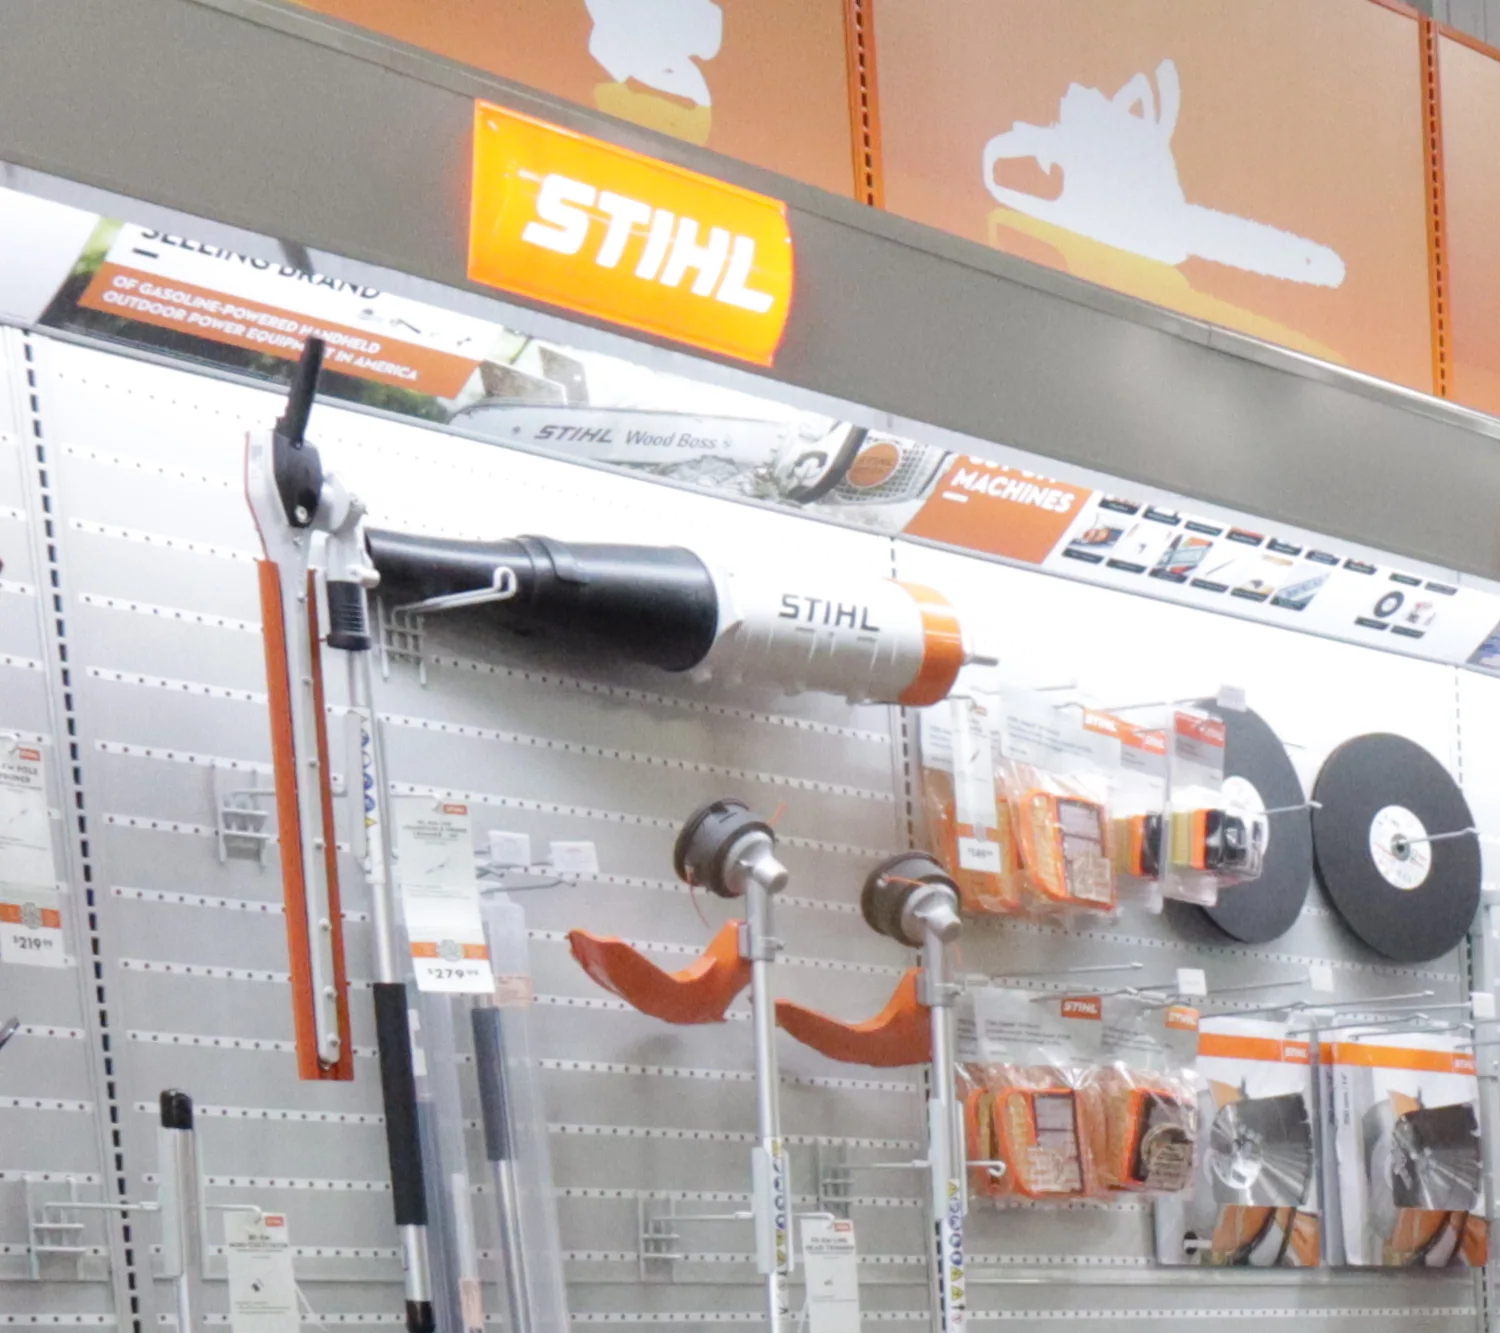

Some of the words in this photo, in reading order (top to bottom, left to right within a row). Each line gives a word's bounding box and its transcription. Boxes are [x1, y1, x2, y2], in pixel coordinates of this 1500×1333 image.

[521, 174, 775, 315] STIHL
[112, 275, 136, 290] OF
[138, 281, 299, 334] GASOLINE-POWERED
[102, 290, 187, 318] OUTDOOR
[187, 312, 245, 337] POWER
[335, 350, 350, 363] IN
[352, 354, 418, 381] AMERICA
[534, 425, 613, 444] STIHL
[626, 430, 673, 448] Wood
[676, 433, 717, 450] Boss
[952, 469, 1075, 513] MACHINES
[778, 594, 880, 631] STIHL
[1063, 1000, 1098, 1015] STIHL
